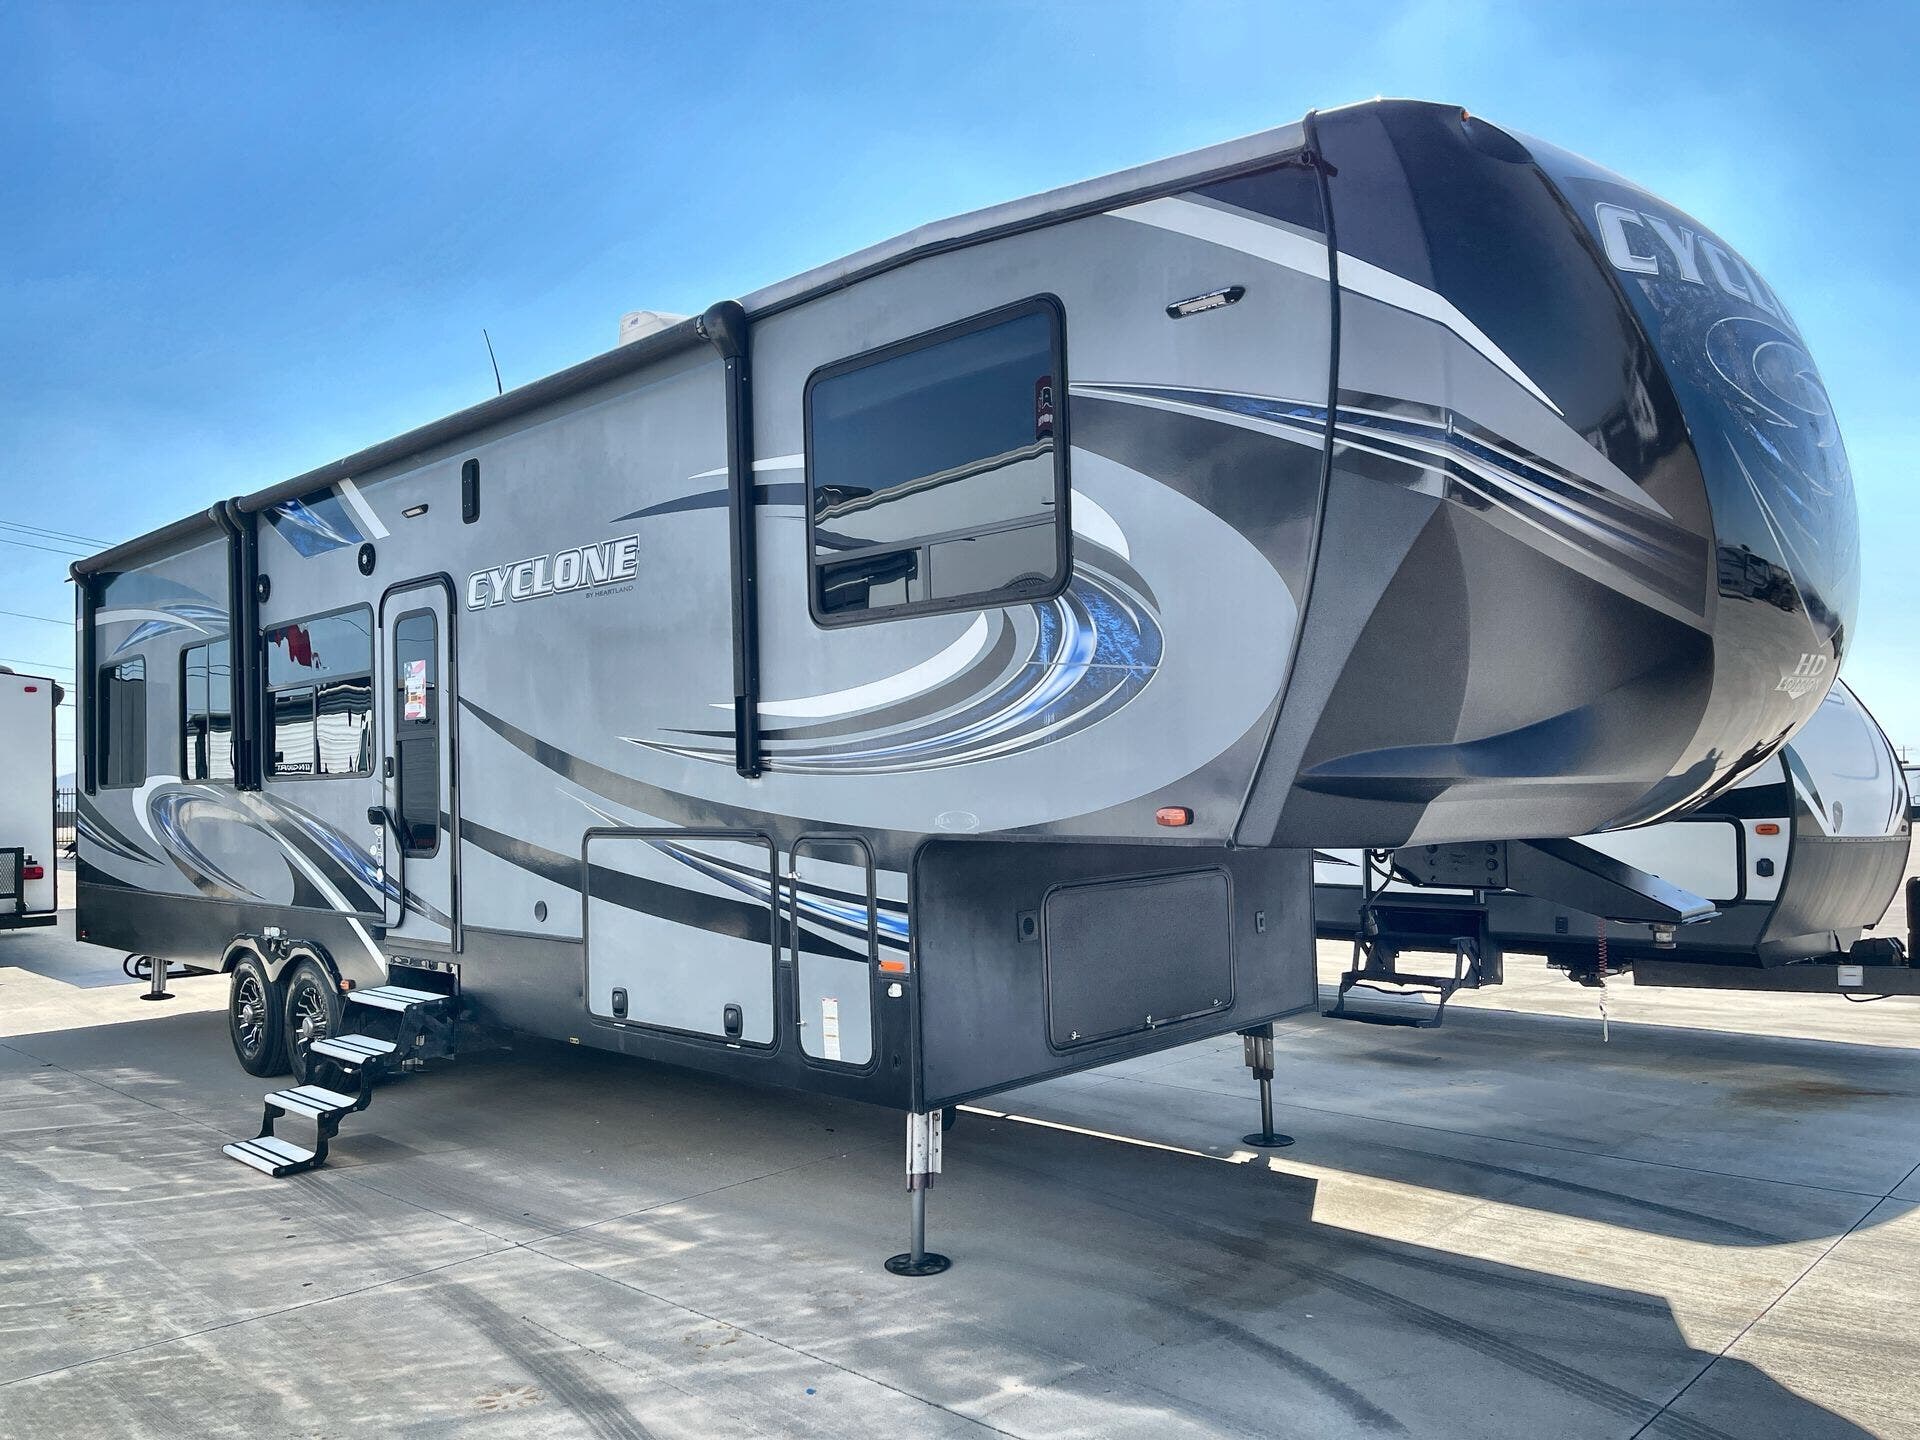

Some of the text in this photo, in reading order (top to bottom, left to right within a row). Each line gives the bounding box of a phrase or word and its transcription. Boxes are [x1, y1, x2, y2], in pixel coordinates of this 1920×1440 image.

[466, 534, 640, 611] CYCLONE
[594, 585, 634, 598] HEARTLAND
[1793, 653, 1827, 676] HD
